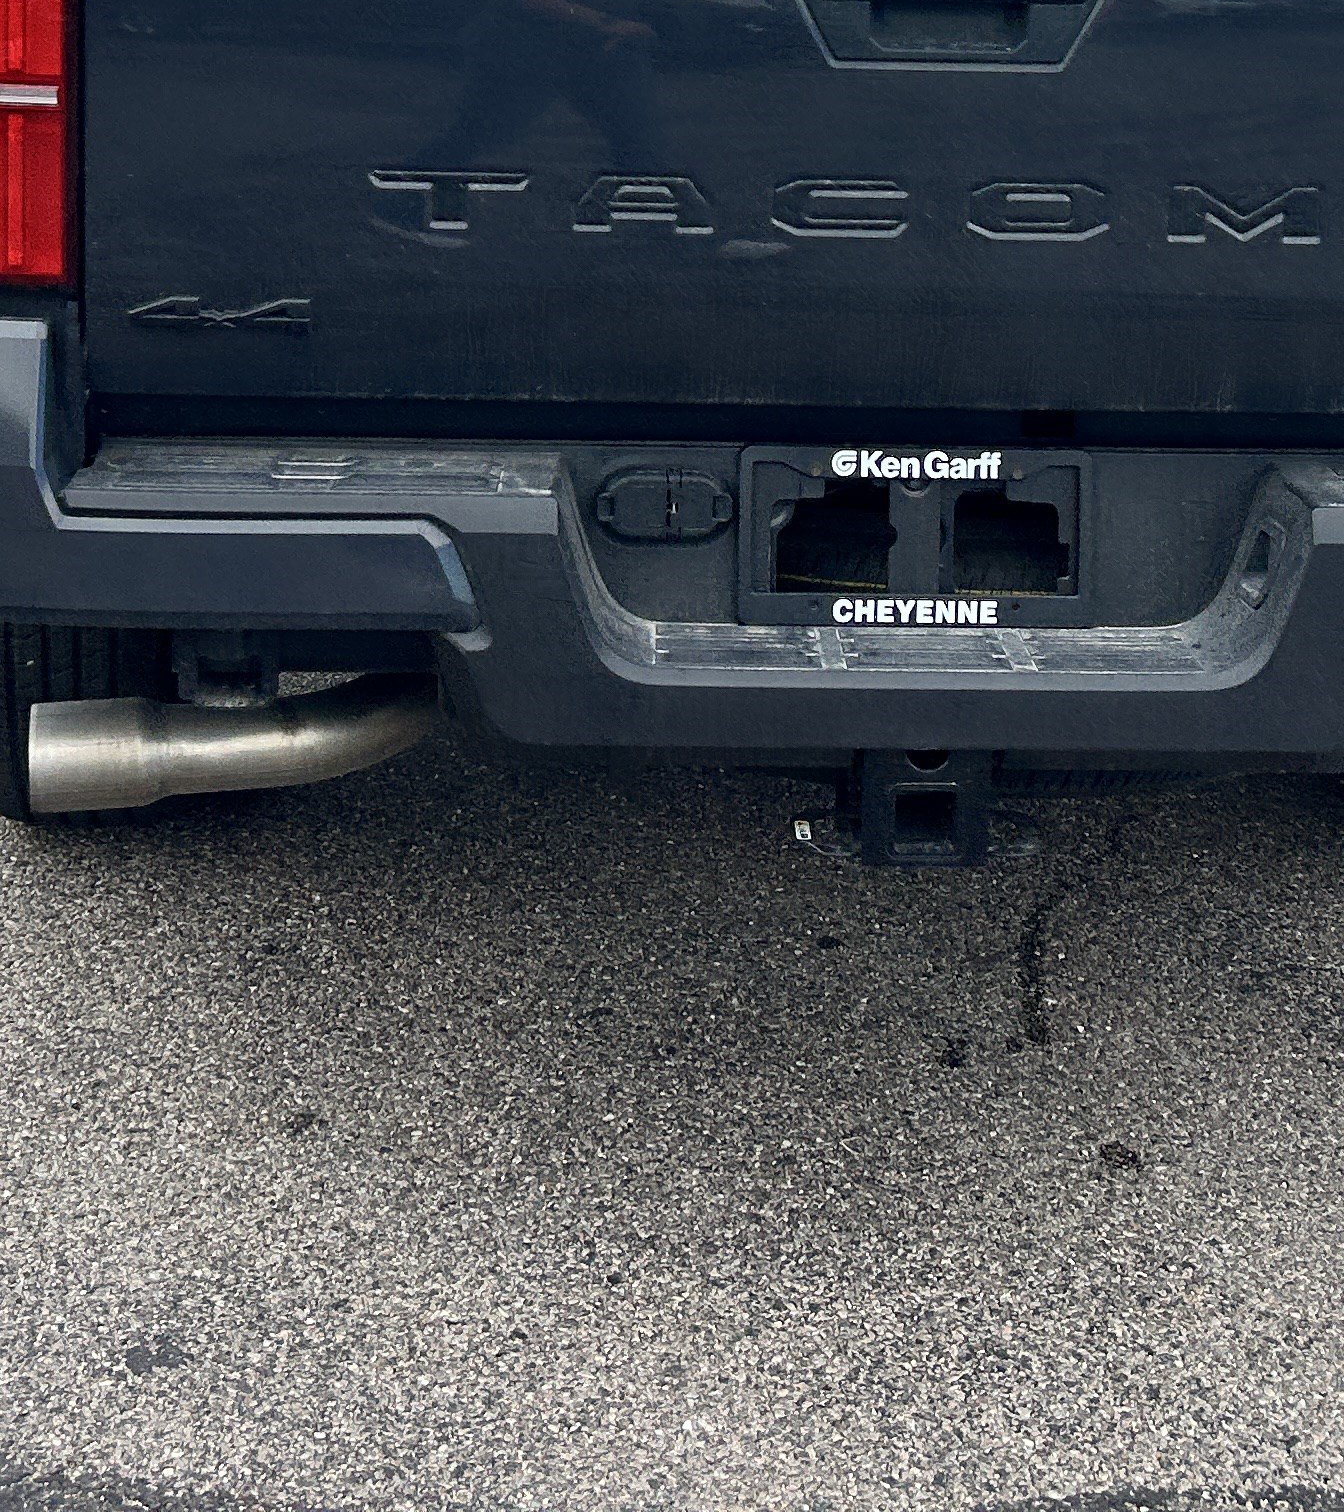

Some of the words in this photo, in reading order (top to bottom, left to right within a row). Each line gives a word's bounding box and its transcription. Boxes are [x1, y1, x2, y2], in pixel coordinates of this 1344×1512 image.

[859, 449, 922, 479] Ken
[923, 449, 1003, 480] Garff
[831, 598, 999, 625] CHEYENNE
